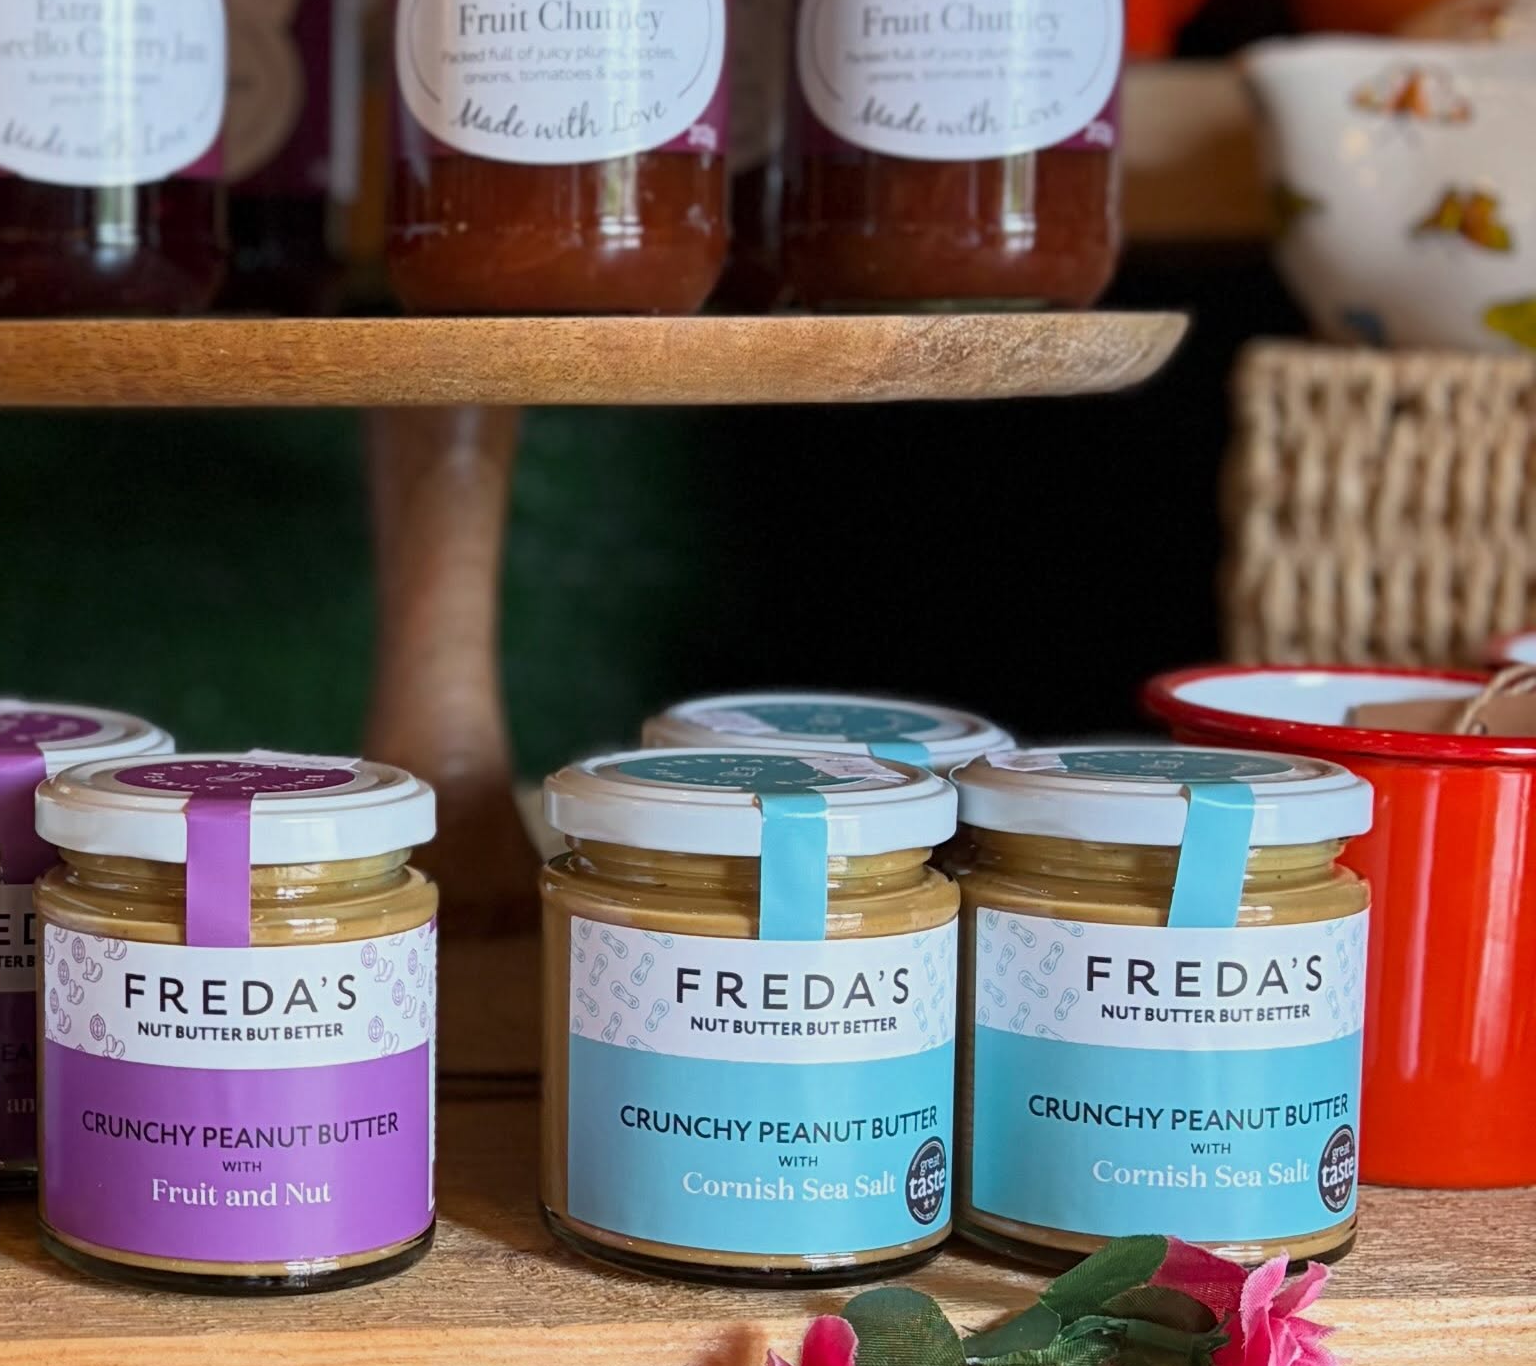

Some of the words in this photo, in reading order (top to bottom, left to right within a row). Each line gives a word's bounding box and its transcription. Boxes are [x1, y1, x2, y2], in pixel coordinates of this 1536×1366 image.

[459, 3, 528, 36] Fruit
[538, 0, 664, 40] Chutney
[862, 5, 930, 38] Fruit
[940, 2, 1063, 42] Chutey
[77, 27, 169, 66] Cerry
[489, 46, 514, 61] full
[518, 46, 534, 60] of
[451, 99, 528, 138] Made
[534, 101, 599, 140] with
[610, 99, 667, 133] Love
[676, 967, 910, 1010] FREDA'S
[1086, 955, 1322, 997] FREDA'S
[125, 973, 357, 1017] FREDA'S
[691, 1016, 729, 1033] NUT
[733, 1020, 803, 1036] BUTTER
[806, 1021, 840, 1036] BUT
[843, 1016, 897, 1034] BETTER
[1101, 1004, 1141, 1020] NUT
[1144, 1006, 1215, 1023] BUTTER
[1219, 1007, 1254, 1023] BUT
[1256, 1004, 1311, 1021] BETTER
[137, 1021, 172, 1038] NUT
[176, 1024, 243, 1042] BUTTER
[246, 1026, 280, 1041] BUT
[284, 1022, 344, 1040] BETTER
[620, 1105, 752, 1142] CRUNCHY
[759, 1120, 866, 1144] PEANUT
[871, 1105, 938, 1139] BUTTER
[1028, 1094, 1164, 1129] CRUNCHY
[1170, 1107, 1281, 1131] PEANUT
[1285, 1093, 1349, 1127] BUTTER
[81, 1110, 196, 1146] CRUNCHY
[203, 1125, 313, 1149] PEANUT
[318, 1111, 399, 1145] BUTTER
[778, 1155, 818, 1168] WITH
[920, 1152, 940, 1176] great
[1190, 1142, 1231, 1155] WITH
[1331, 1140, 1351, 1164] great
[222, 1160, 262, 1173] WITH
[1092, 1160, 1207, 1188] Cornish
[1214, 1164, 1263, 1187] Sea
[1267, 1158, 1311, 1185] Salt
[1321, 1155, 1354, 1188] taste
[152, 1178, 219, 1207] Fruit
[225, 1182, 278, 1208] and
[284, 1181, 332, 1206] Nut
[681, 1171, 795, 1201] Cornish
[802, 1178, 849, 1202] Sea
[854, 1170, 897, 1198] Salt
[909, 1167, 946, 1200] taste
